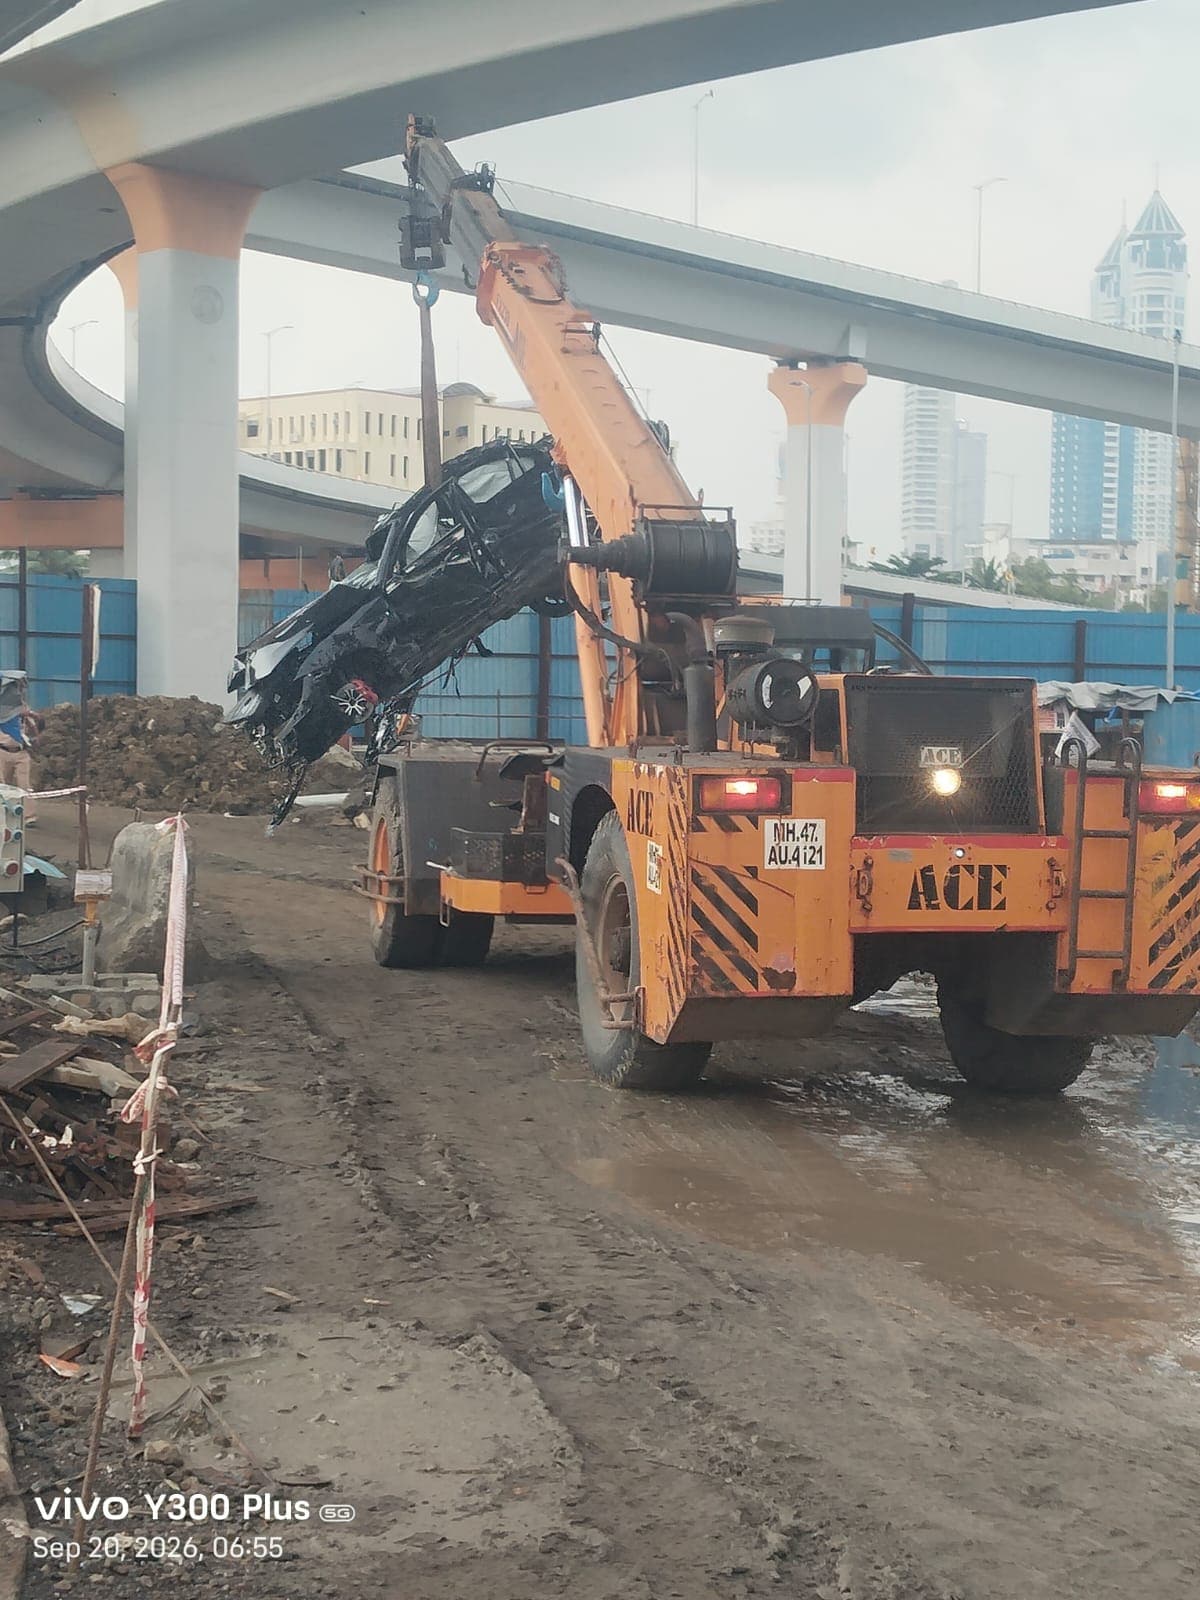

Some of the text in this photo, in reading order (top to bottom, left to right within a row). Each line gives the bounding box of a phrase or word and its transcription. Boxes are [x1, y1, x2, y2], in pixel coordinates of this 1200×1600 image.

[920, 748, 961, 764] ACE
[627, 788, 654, 837] ACE
[907, 864, 1008, 910] ACE
